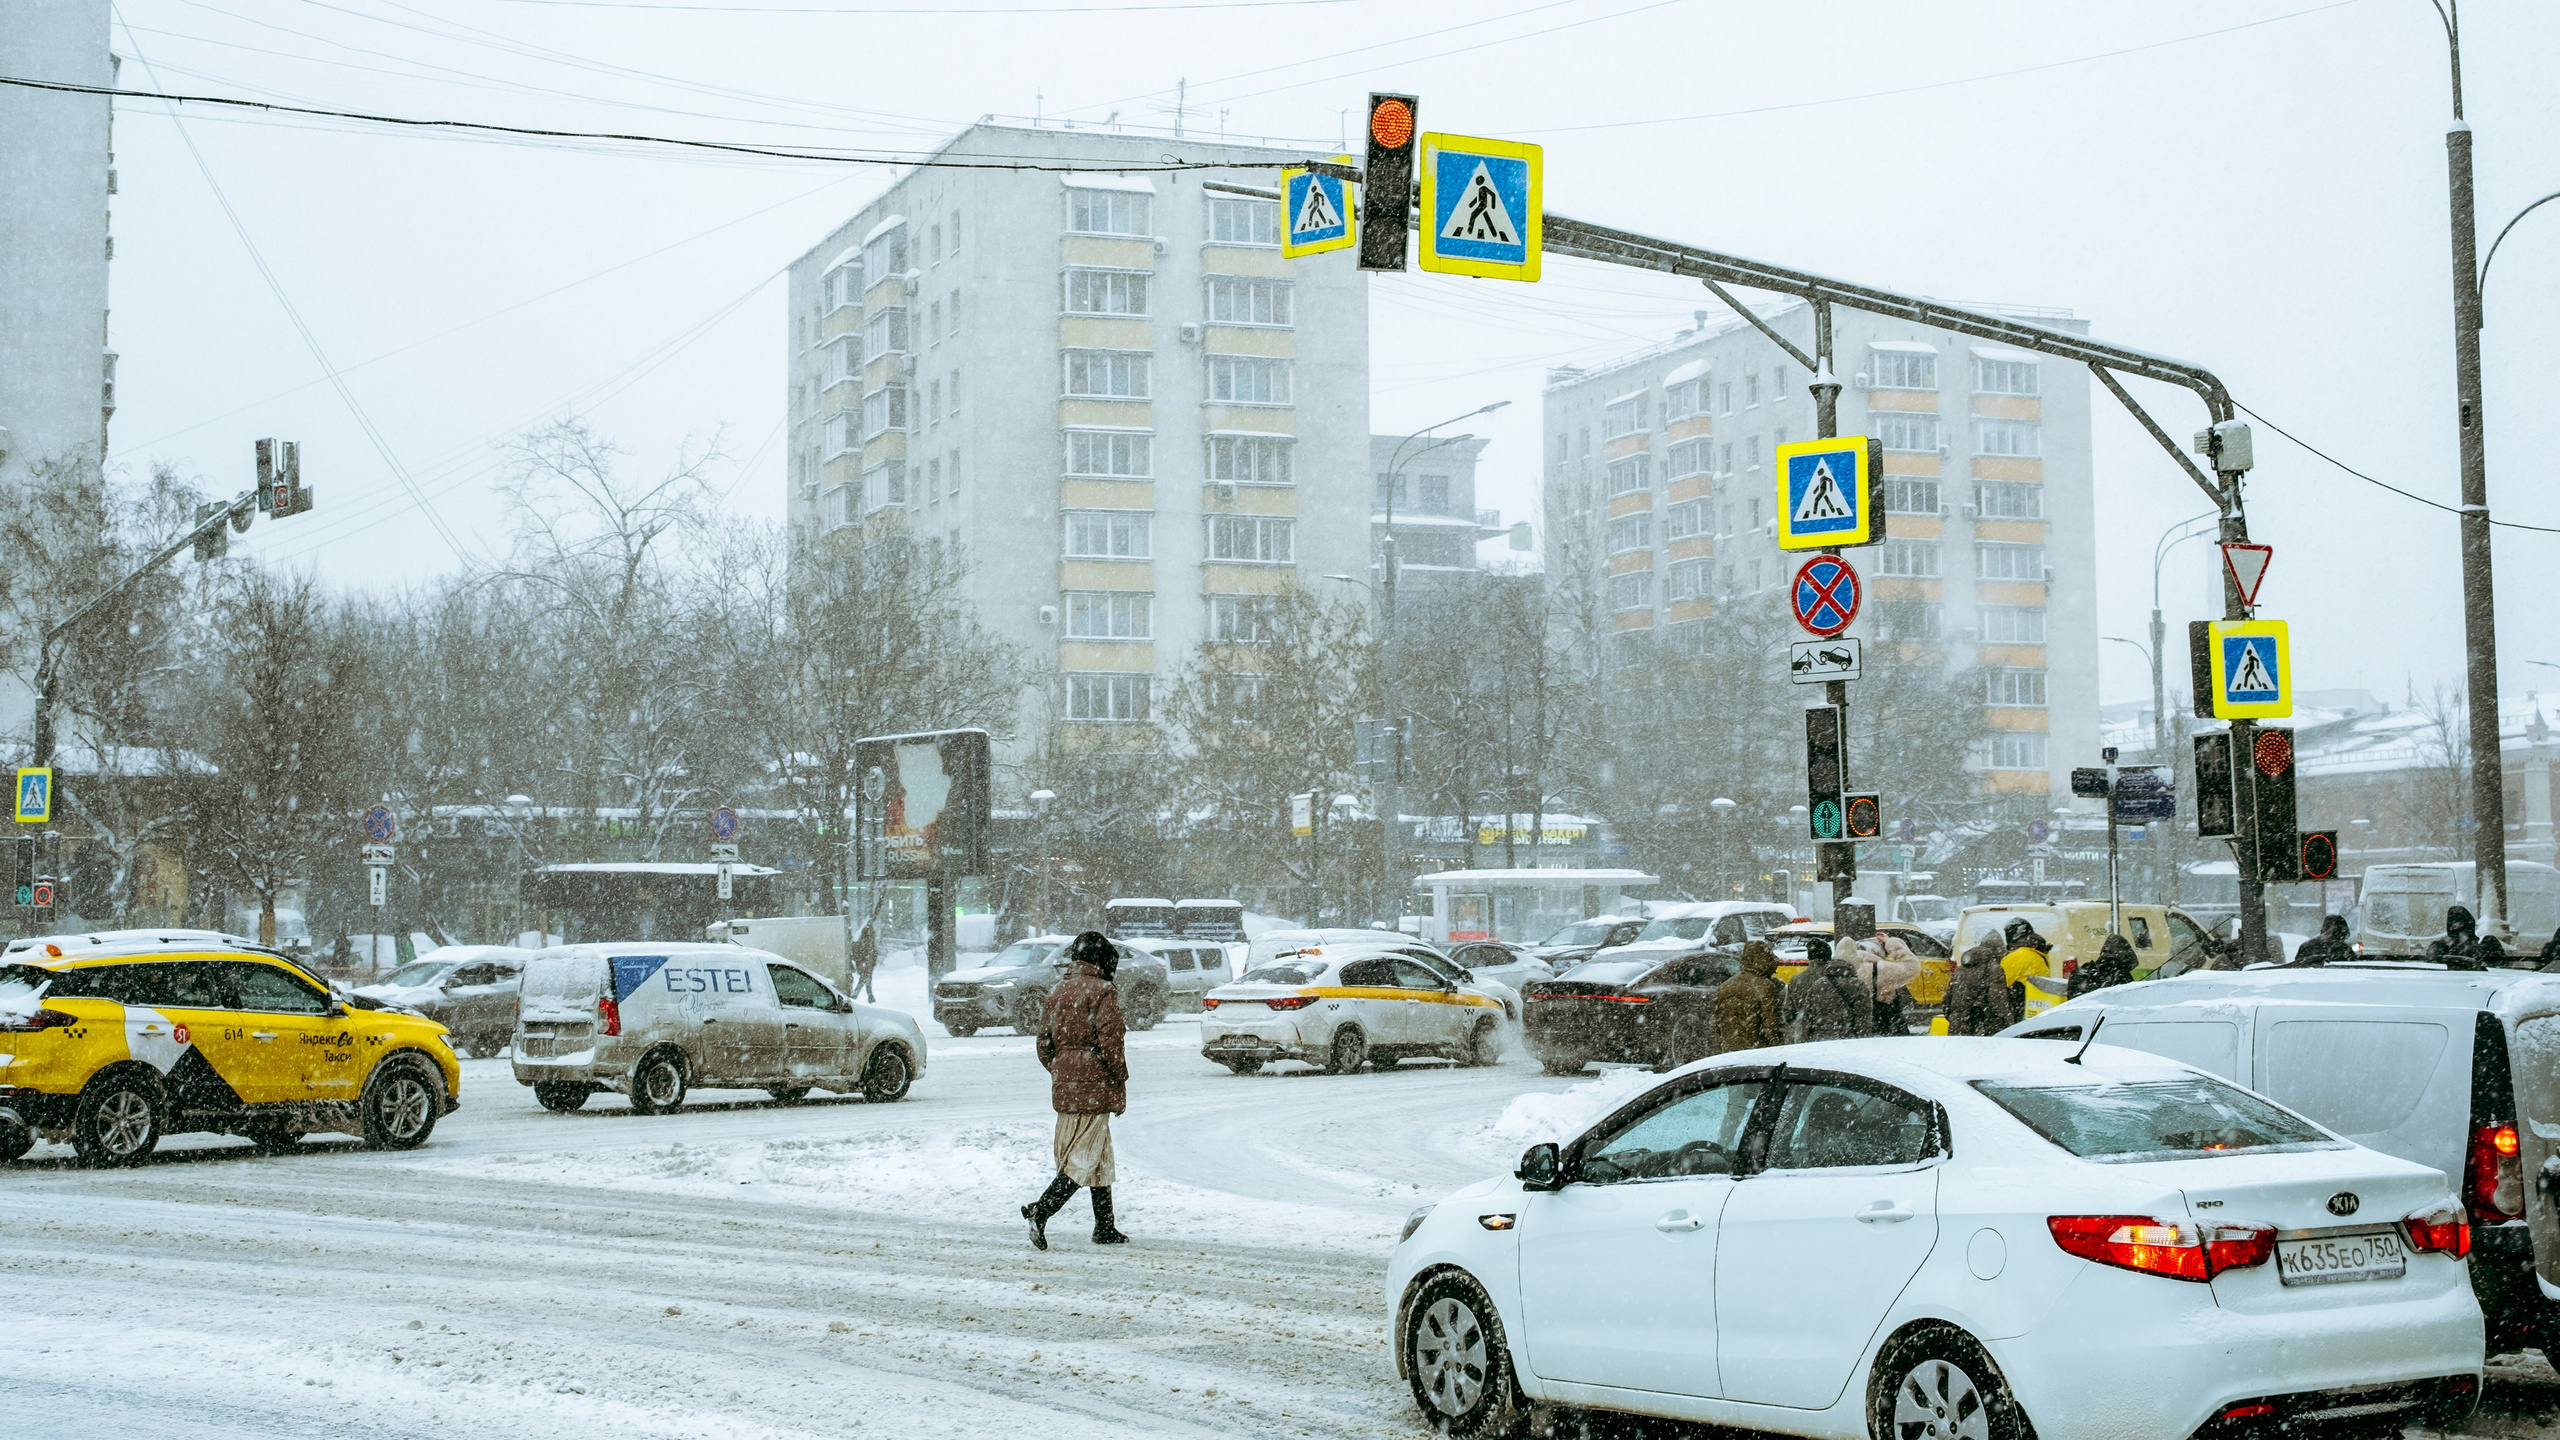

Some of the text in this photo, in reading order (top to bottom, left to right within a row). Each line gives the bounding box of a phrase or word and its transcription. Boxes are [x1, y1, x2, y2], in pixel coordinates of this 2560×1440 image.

[1542, 829, 1587, 838] BAKERY
[224, 1027, 244, 1041] 614
[298, 1031, 354, 1047] Яндекс Go
[323, 1049, 352, 1063] Такси
[2195, 1200, 2224, 1210] RIO
[2332, 1196, 2358, 1211] KIA
[2364, 1237, 2395, 1259] 750
